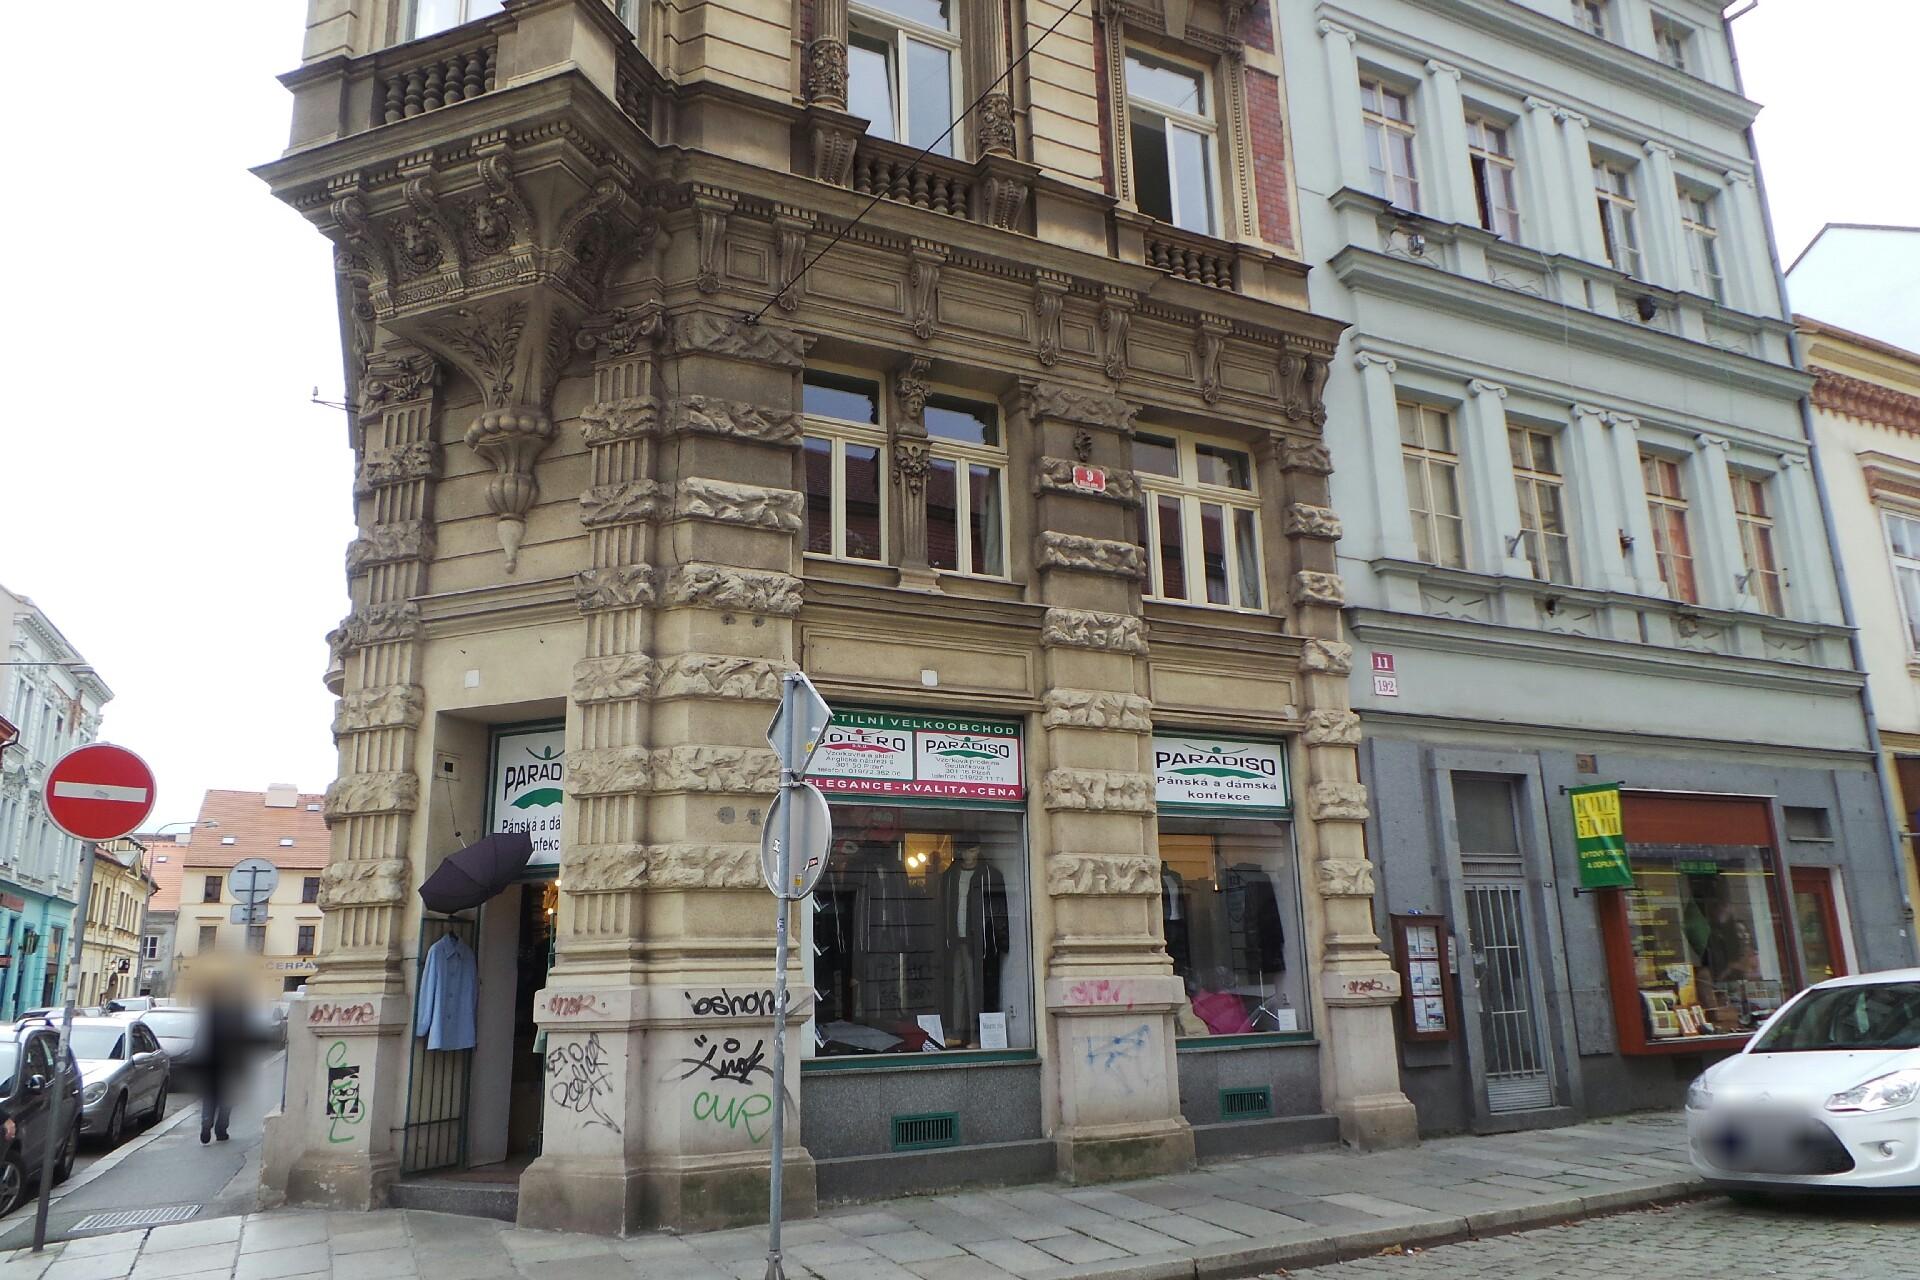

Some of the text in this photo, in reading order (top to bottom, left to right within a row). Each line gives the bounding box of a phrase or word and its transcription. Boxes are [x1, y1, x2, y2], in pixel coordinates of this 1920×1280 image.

[1376, 657, 1389, 669] 11
[1377, 680, 1395, 693] 192
[890, 718, 1014, 735] VELKOOBCHOD
[926, 740, 1010, 759] PARADISO
[1156, 752, 1276, 776] PARADISO
[504, 763, 563, 801] PARAD
[1157, 776, 1208, 787] Pánská
[1226, 778, 1277, 790] dámská
[1188, 790, 1251, 801] konfekce
[502, 815, 560, 833] Pánská a dá
[531, 835, 560, 852] nfekc
